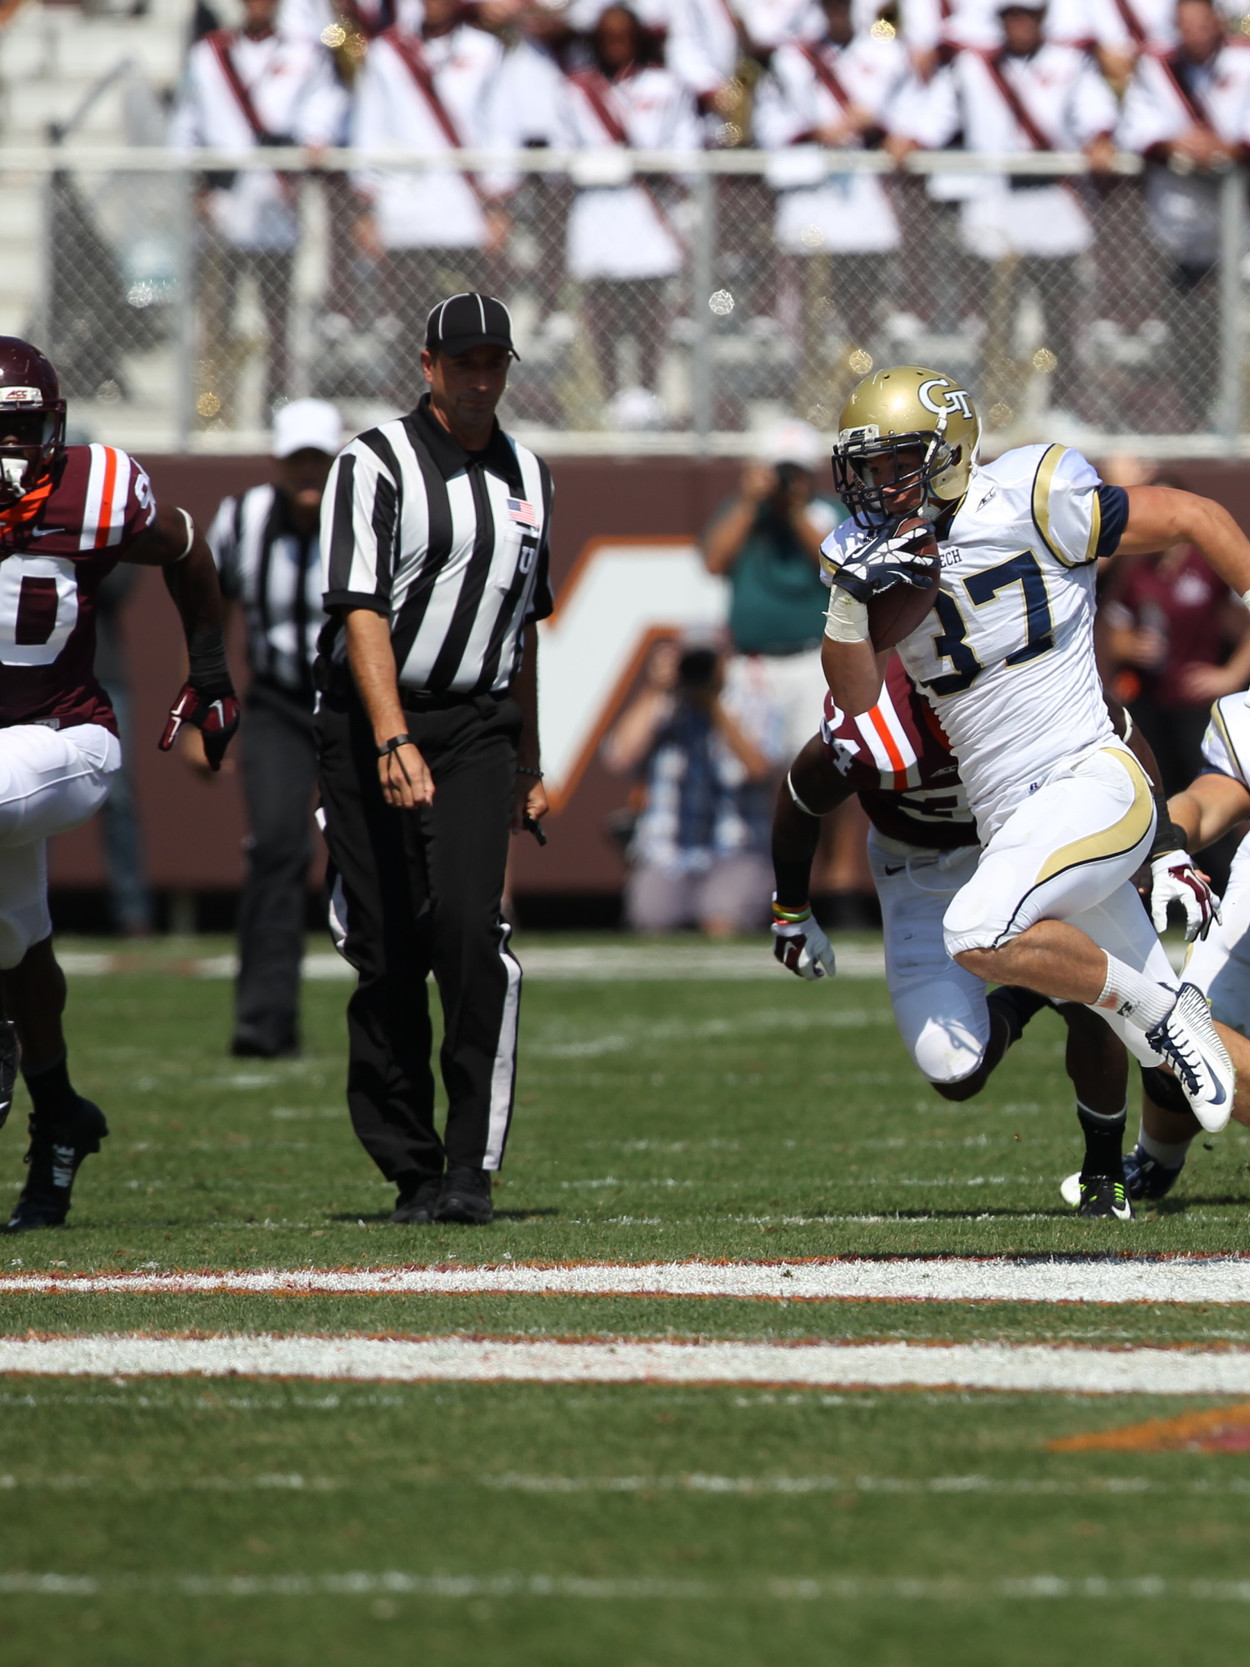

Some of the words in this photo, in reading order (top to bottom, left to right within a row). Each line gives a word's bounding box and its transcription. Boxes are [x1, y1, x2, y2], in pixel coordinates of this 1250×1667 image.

[5, 390, 28, 399] ACC
[918, 378, 973, 420] GT
[519, 545, 536, 574] U
[939, 549, 962, 568] ECH
[918, 548, 1055, 698] 37
[52, 1144, 75, 1188] NIKE
